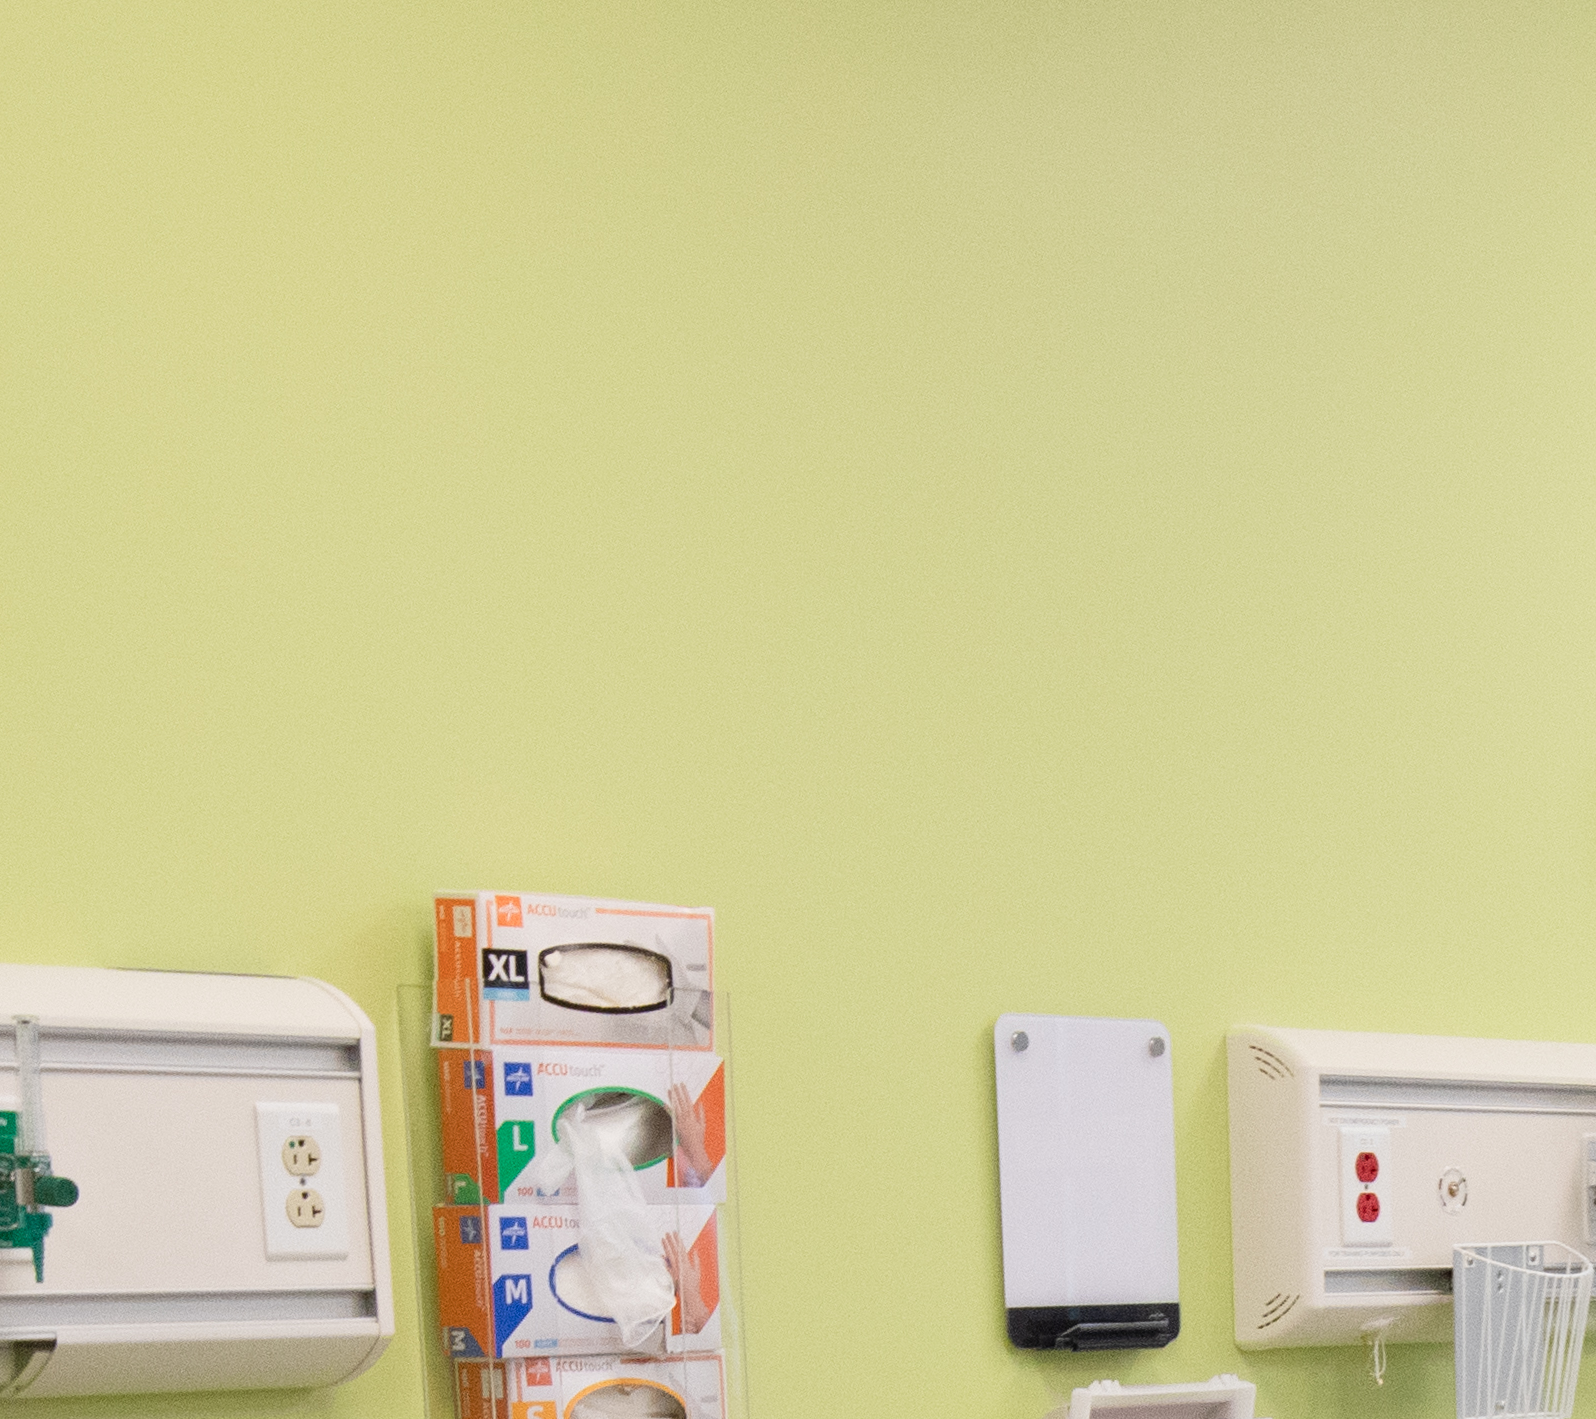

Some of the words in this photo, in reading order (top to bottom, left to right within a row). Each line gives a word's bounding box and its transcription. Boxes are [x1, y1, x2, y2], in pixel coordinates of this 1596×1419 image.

[487, 954, 525, 983] XL
[442, 1017, 452, 1039] XL
[512, 1125, 528, 1151] L
[505, 1279, 528, 1305] M
[451, 1330, 466, 1350] M
